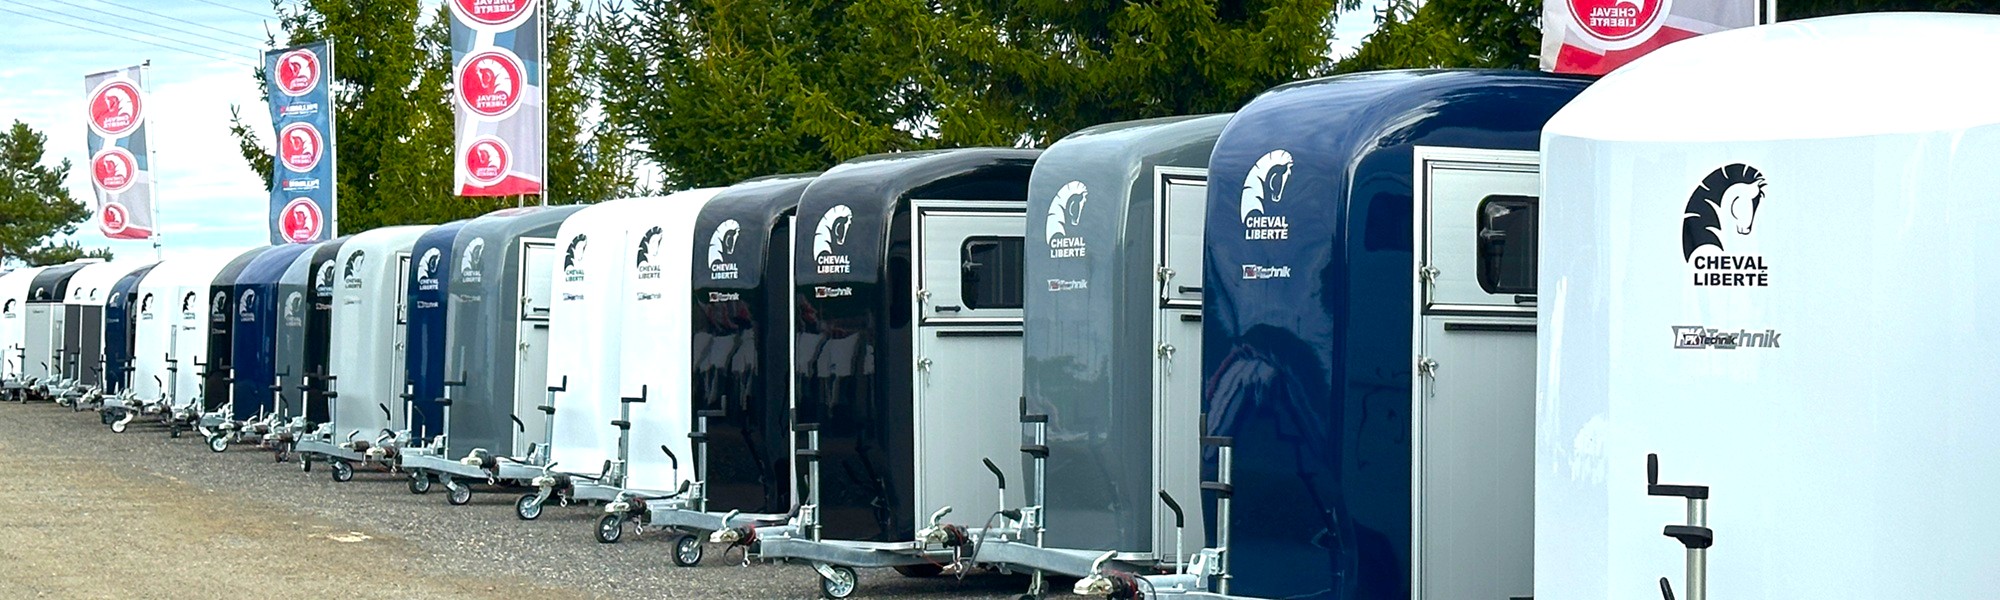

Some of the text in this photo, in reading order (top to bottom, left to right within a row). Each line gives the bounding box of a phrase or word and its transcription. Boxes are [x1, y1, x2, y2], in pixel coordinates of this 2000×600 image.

[1246, 216, 1288, 228] CHEVAL
[1051, 237, 1085, 248] CHEVAL
[818, 255, 850, 265] CHEVAL
[1694, 256, 1768, 270] CHEVAL
[711, 263, 738, 272] CHEVAL
[1694, 270, 1768, 286] LIBERTÉ
